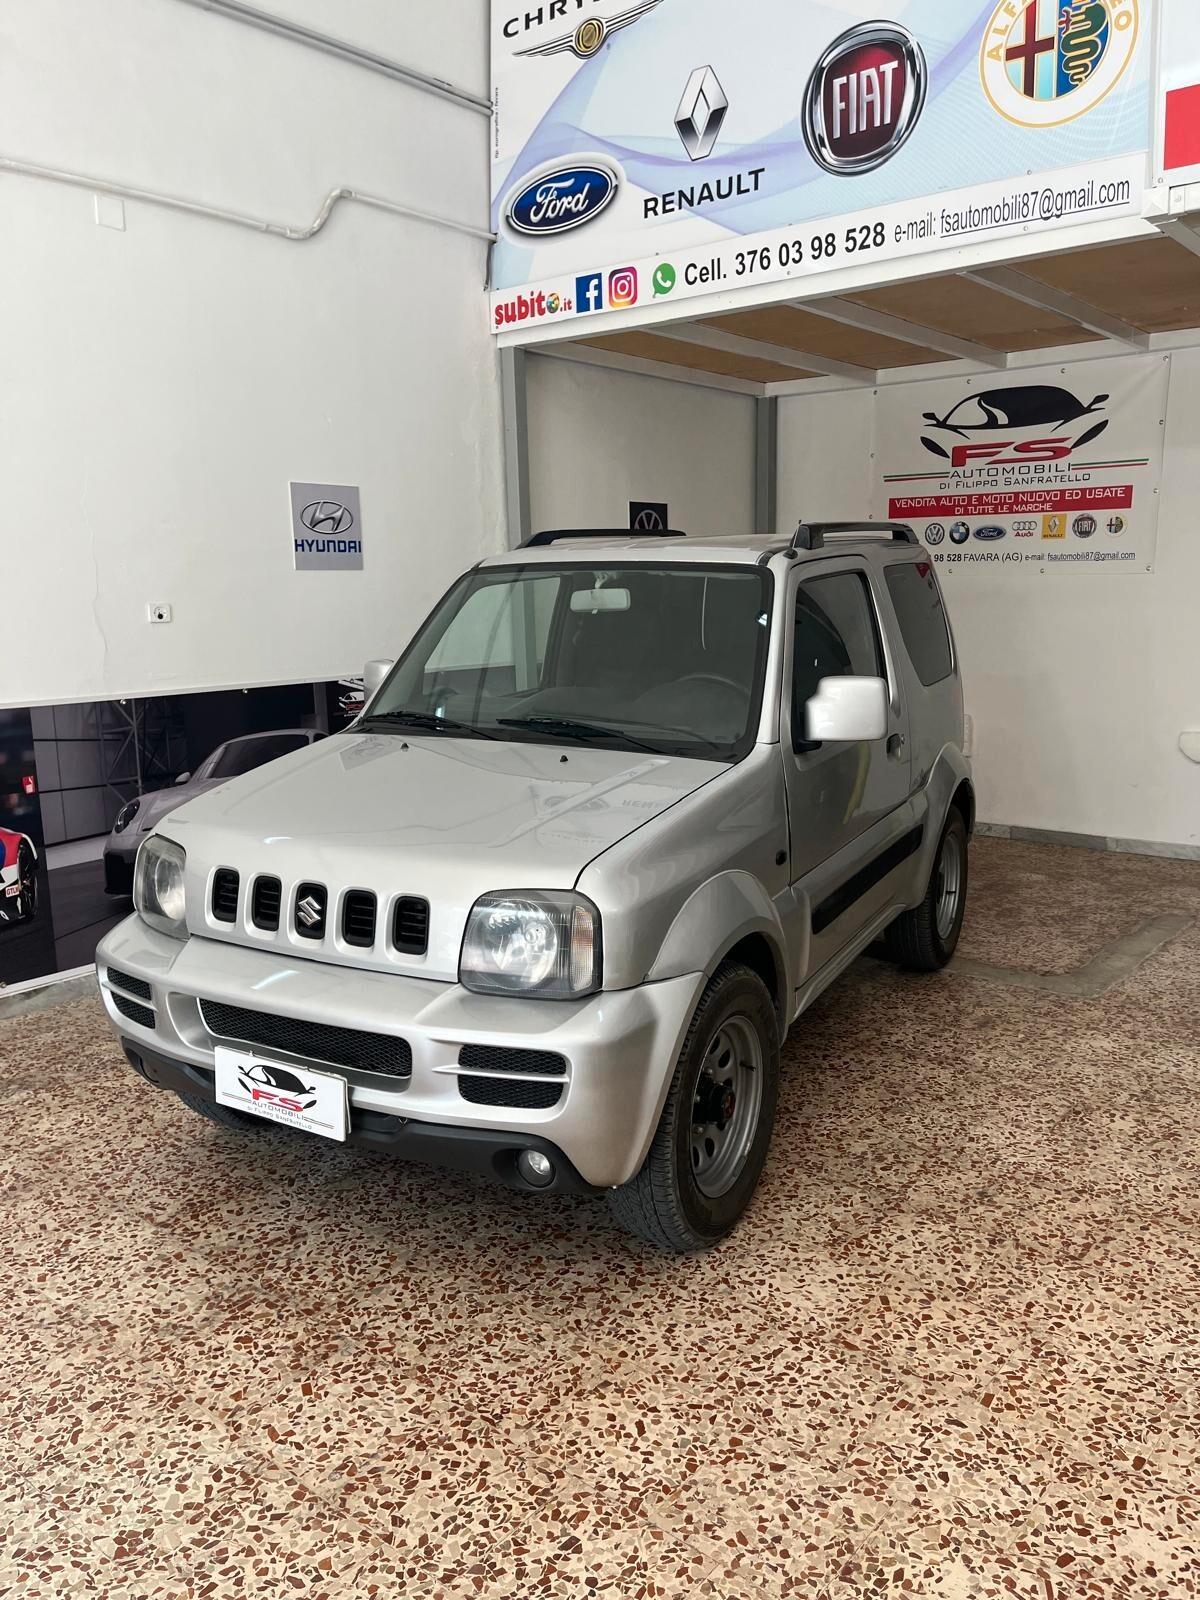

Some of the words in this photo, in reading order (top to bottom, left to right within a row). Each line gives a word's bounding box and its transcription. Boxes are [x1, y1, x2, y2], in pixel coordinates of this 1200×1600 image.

[503, 0, 603, 38] CHR
[986, 0, 1028, 62] ALF
[832, 60, 899, 140] FIAT
[529, 178, 590, 223] Ford
[643, 168, 766, 219] RENAULT
[684, 257, 727, 285] Cell.
[735, 247, 771, 276] 376
[778, 240, 803, 267] 03
[810, 233, 836, 260] 98
[844, 222, 886, 253] 528
[894, 211, 936, 243] e-mail:
[940, 179, 1130, 237] fsautomobili87@gmail.com
[951, 437, 1072, 468] FS
[940, 482, 950, 490] DI
[955, 479, 998, 489] FILIPPO
[1003, 473, 1091, 486] SANFRATELLO
[950, 462, 1072, 479] AUTOMOBILI
[895, 497, 937, 508] VENDITA
[940, 496, 968, 506] AUTO
[972, 495, 979, 504] E
[982, 493, 1014, 504] MOTO
[1019, 491, 1060, 502] NUOVO
[1065, 489, 1082, 500] ED
[1086, 487, 1126, 499] USATE
[955, 507, 964, 515] DI
[968, 505, 995, 514] TUTTE
[998, 504, 1010, 513] LE
[1013, 502, 1053, 512] MARCHE
[1079, 520, 1093, 532] FIAT
[294, 539, 362, 553] HYUNDAI
[934, 553, 944, 562] 98
[946, 553, 962, 562] 528
[963, 552, 1000, 562] FAVARA
[1001, 552, 1023, 563] (AG)
[252, 1100, 304, 1120] AUTOMOBILI
[253, 1088, 304, 1112] FS
